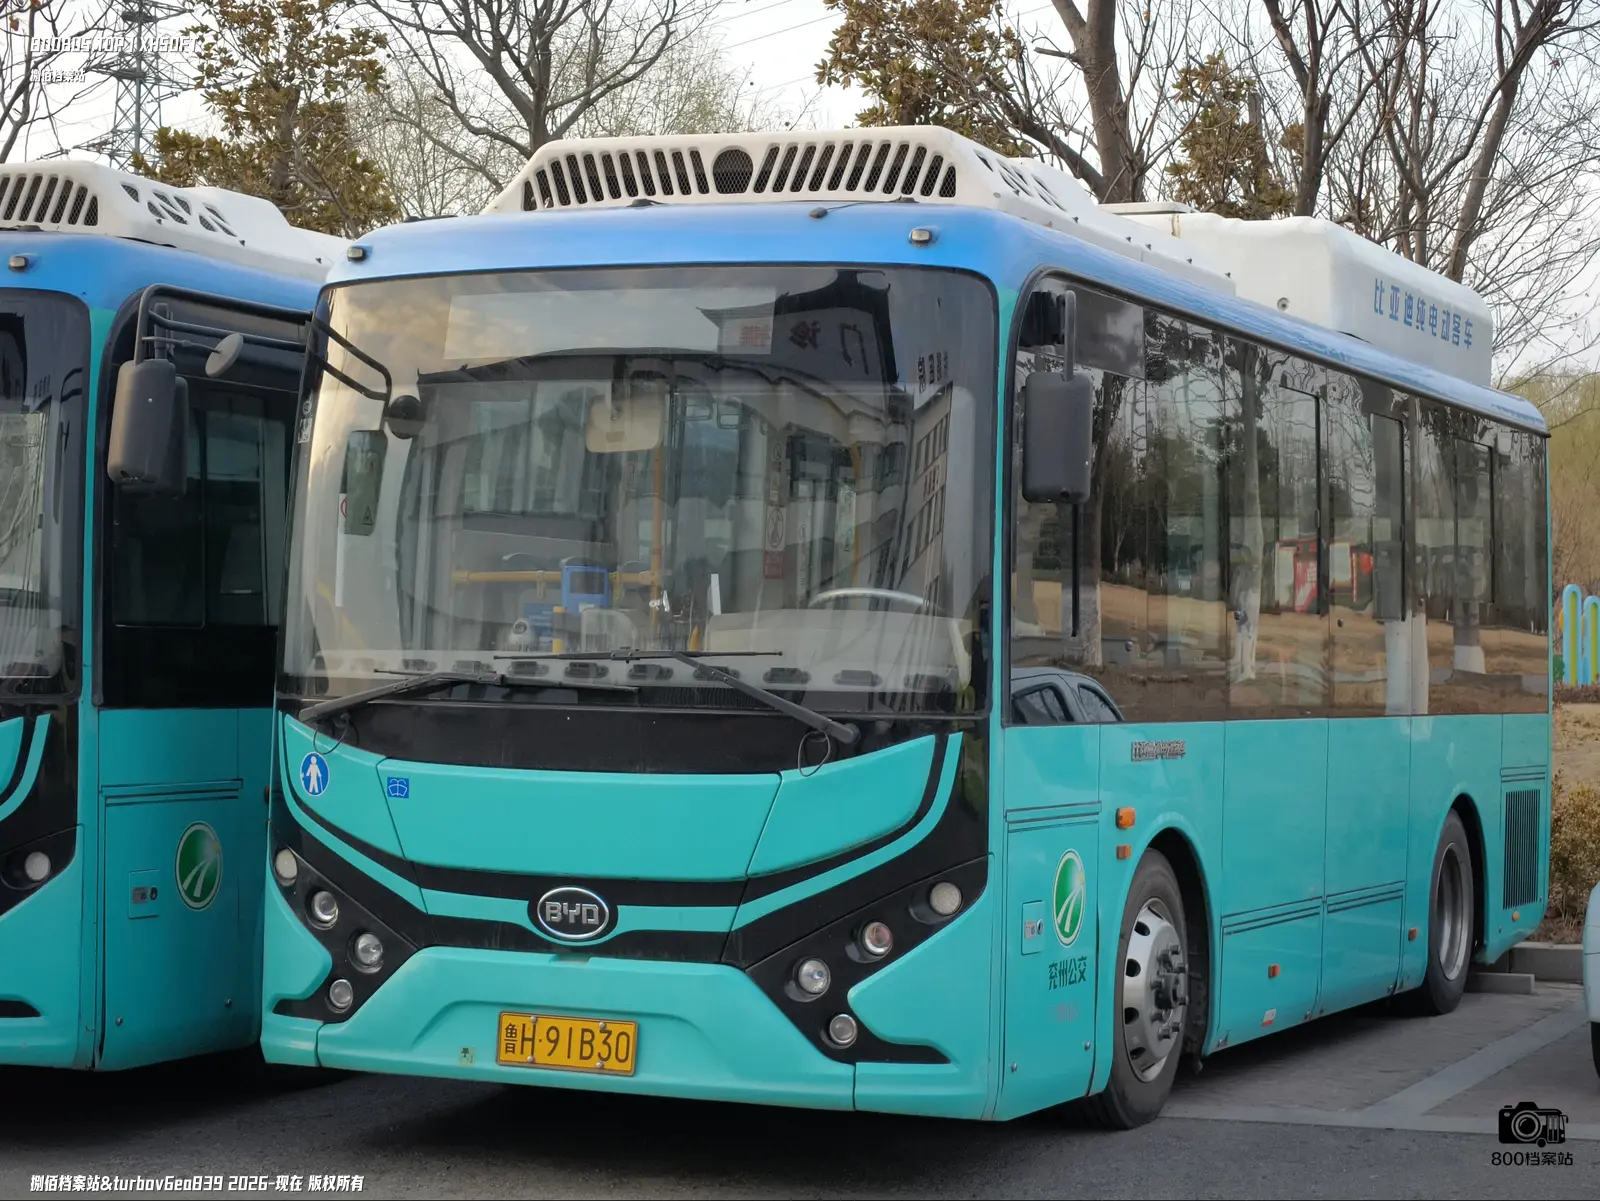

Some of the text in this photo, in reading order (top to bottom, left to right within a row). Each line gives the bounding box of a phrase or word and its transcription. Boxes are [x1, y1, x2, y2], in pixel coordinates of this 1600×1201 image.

[1373, 278, 1473, 350] 比亚迪纯电动客车
[545, 901, 600, 926] BYD
[1048, 956, 1088, 991] 兖州公交
